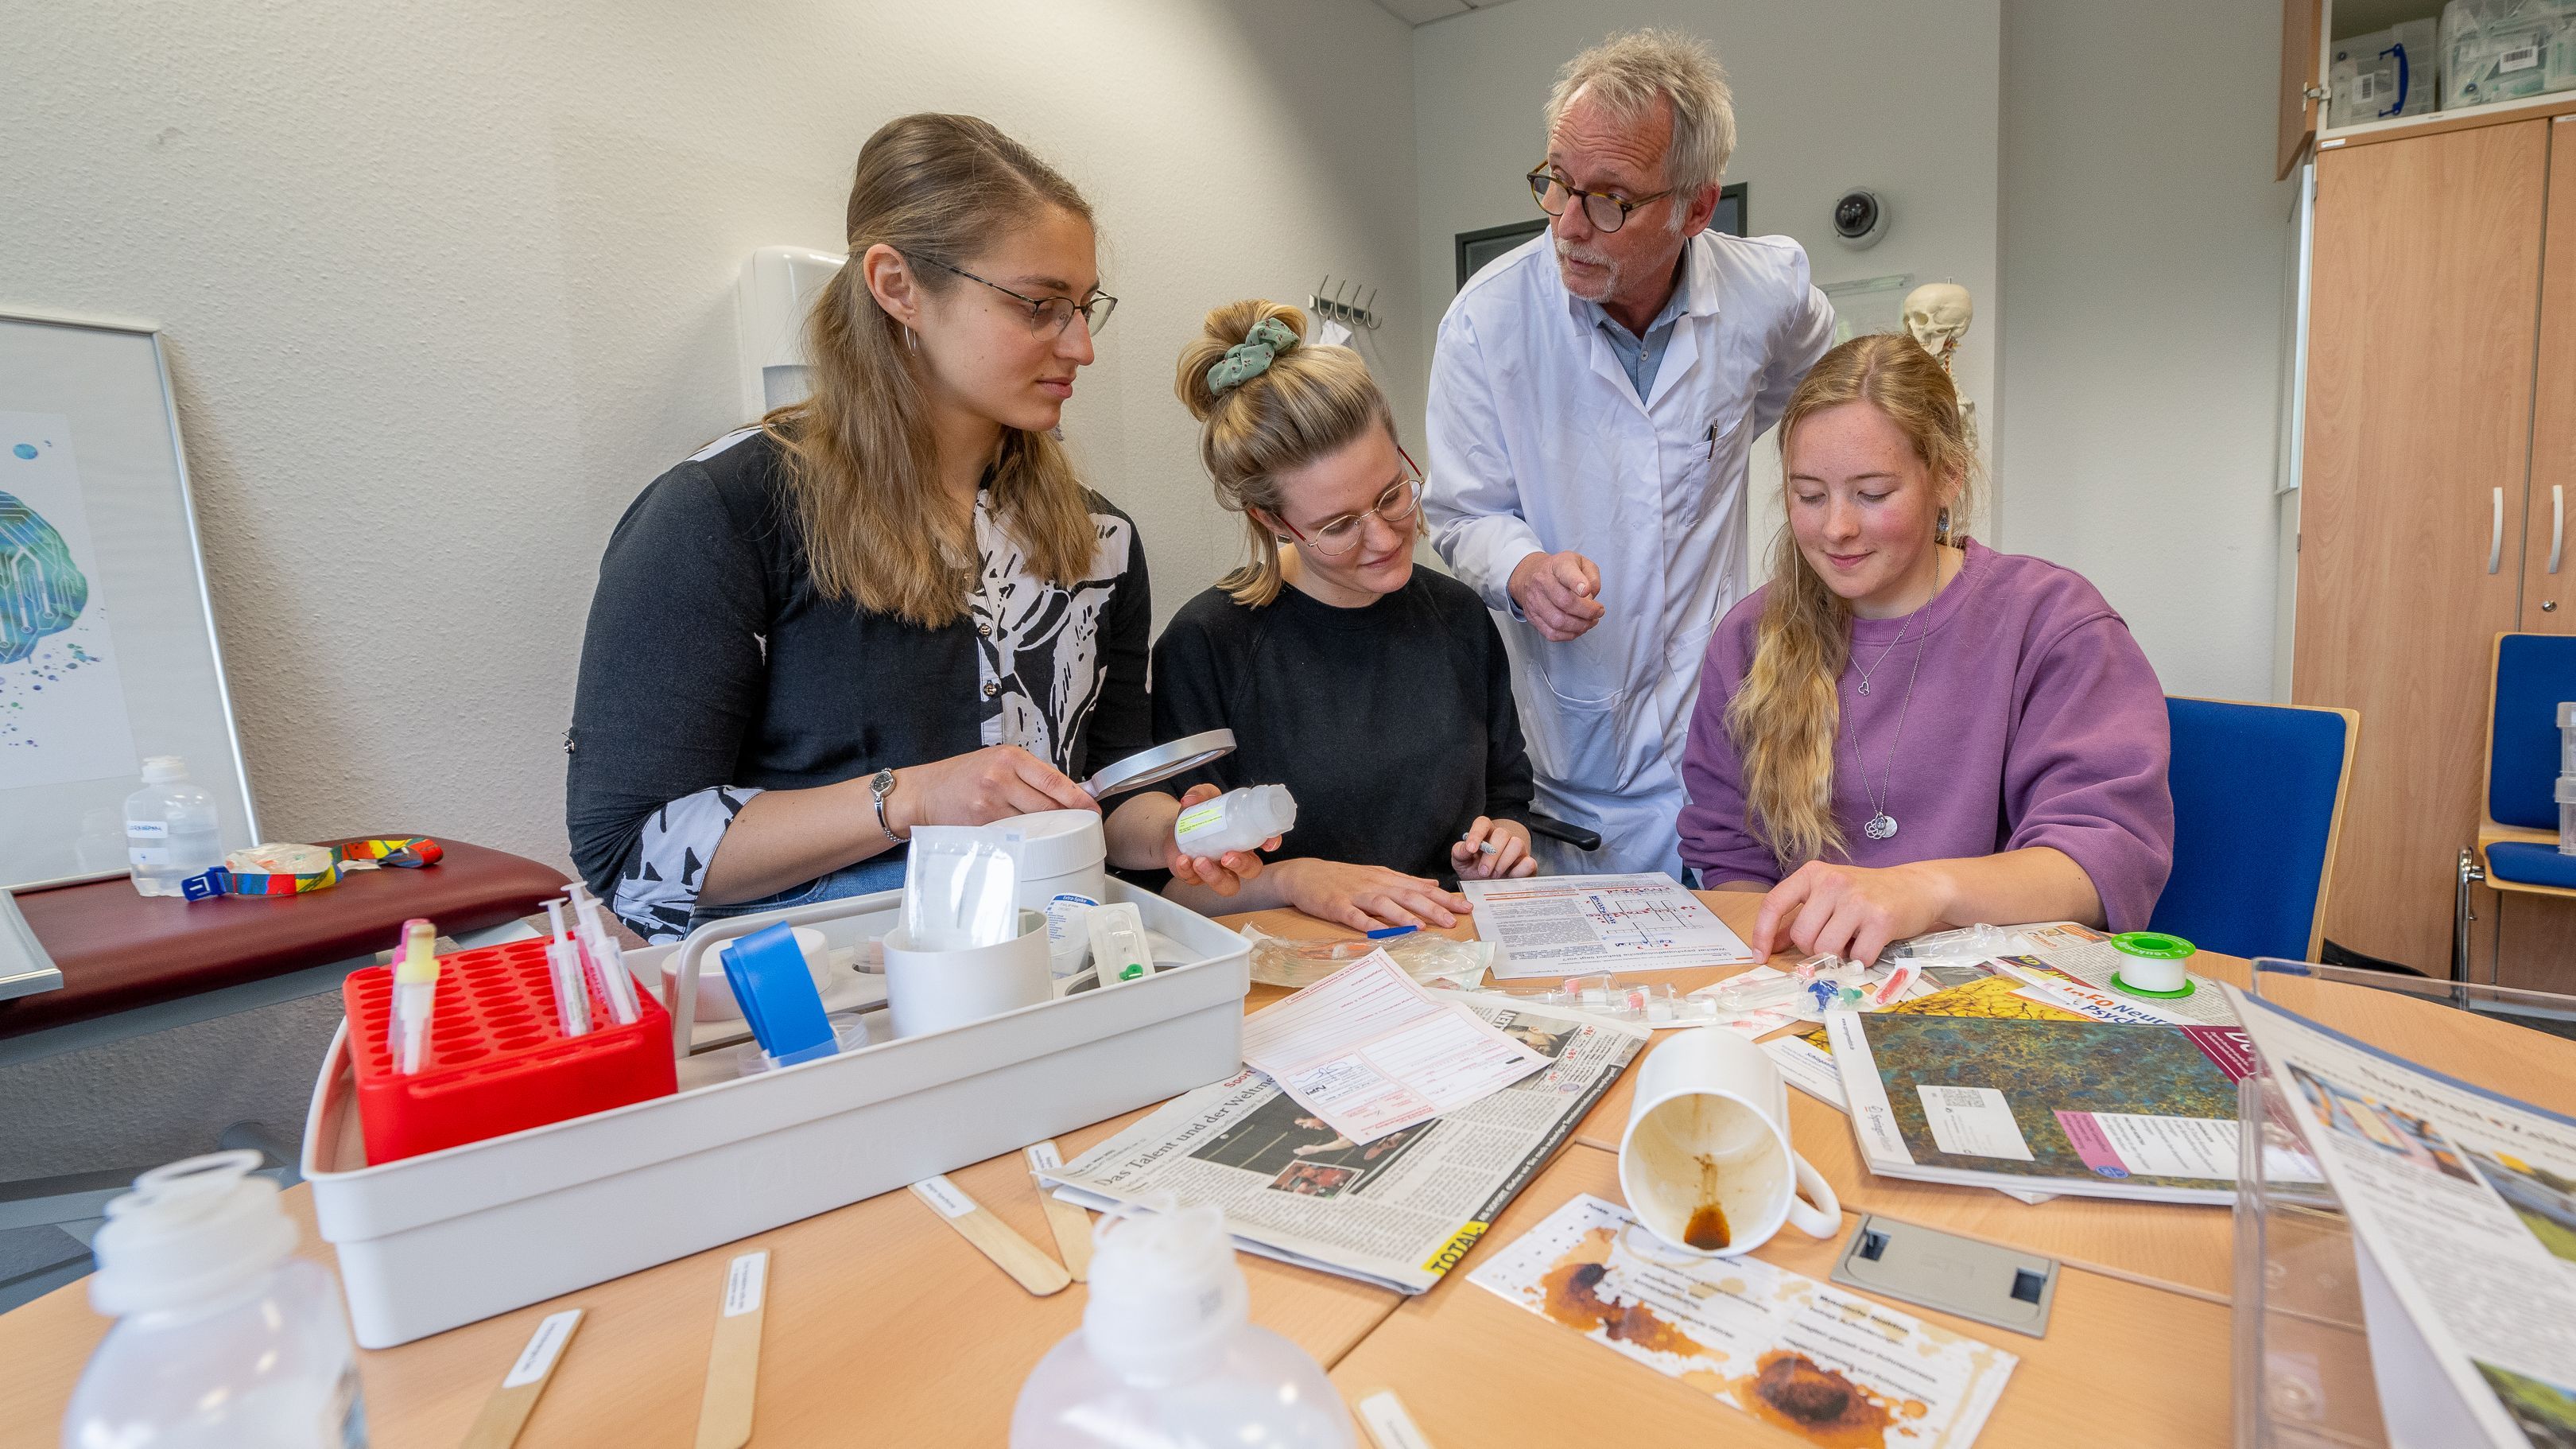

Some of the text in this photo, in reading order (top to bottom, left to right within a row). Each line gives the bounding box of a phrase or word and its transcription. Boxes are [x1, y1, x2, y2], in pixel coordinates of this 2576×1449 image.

[1224, 1068, 1257, 1089] Sport
[1094, 1169, 1131, 1187] Das
[1125, 1140, 1179, 1170] Talent
[1176, 1122, 1208, 1144] und
[1204, 1104, 1229, 1125] der
